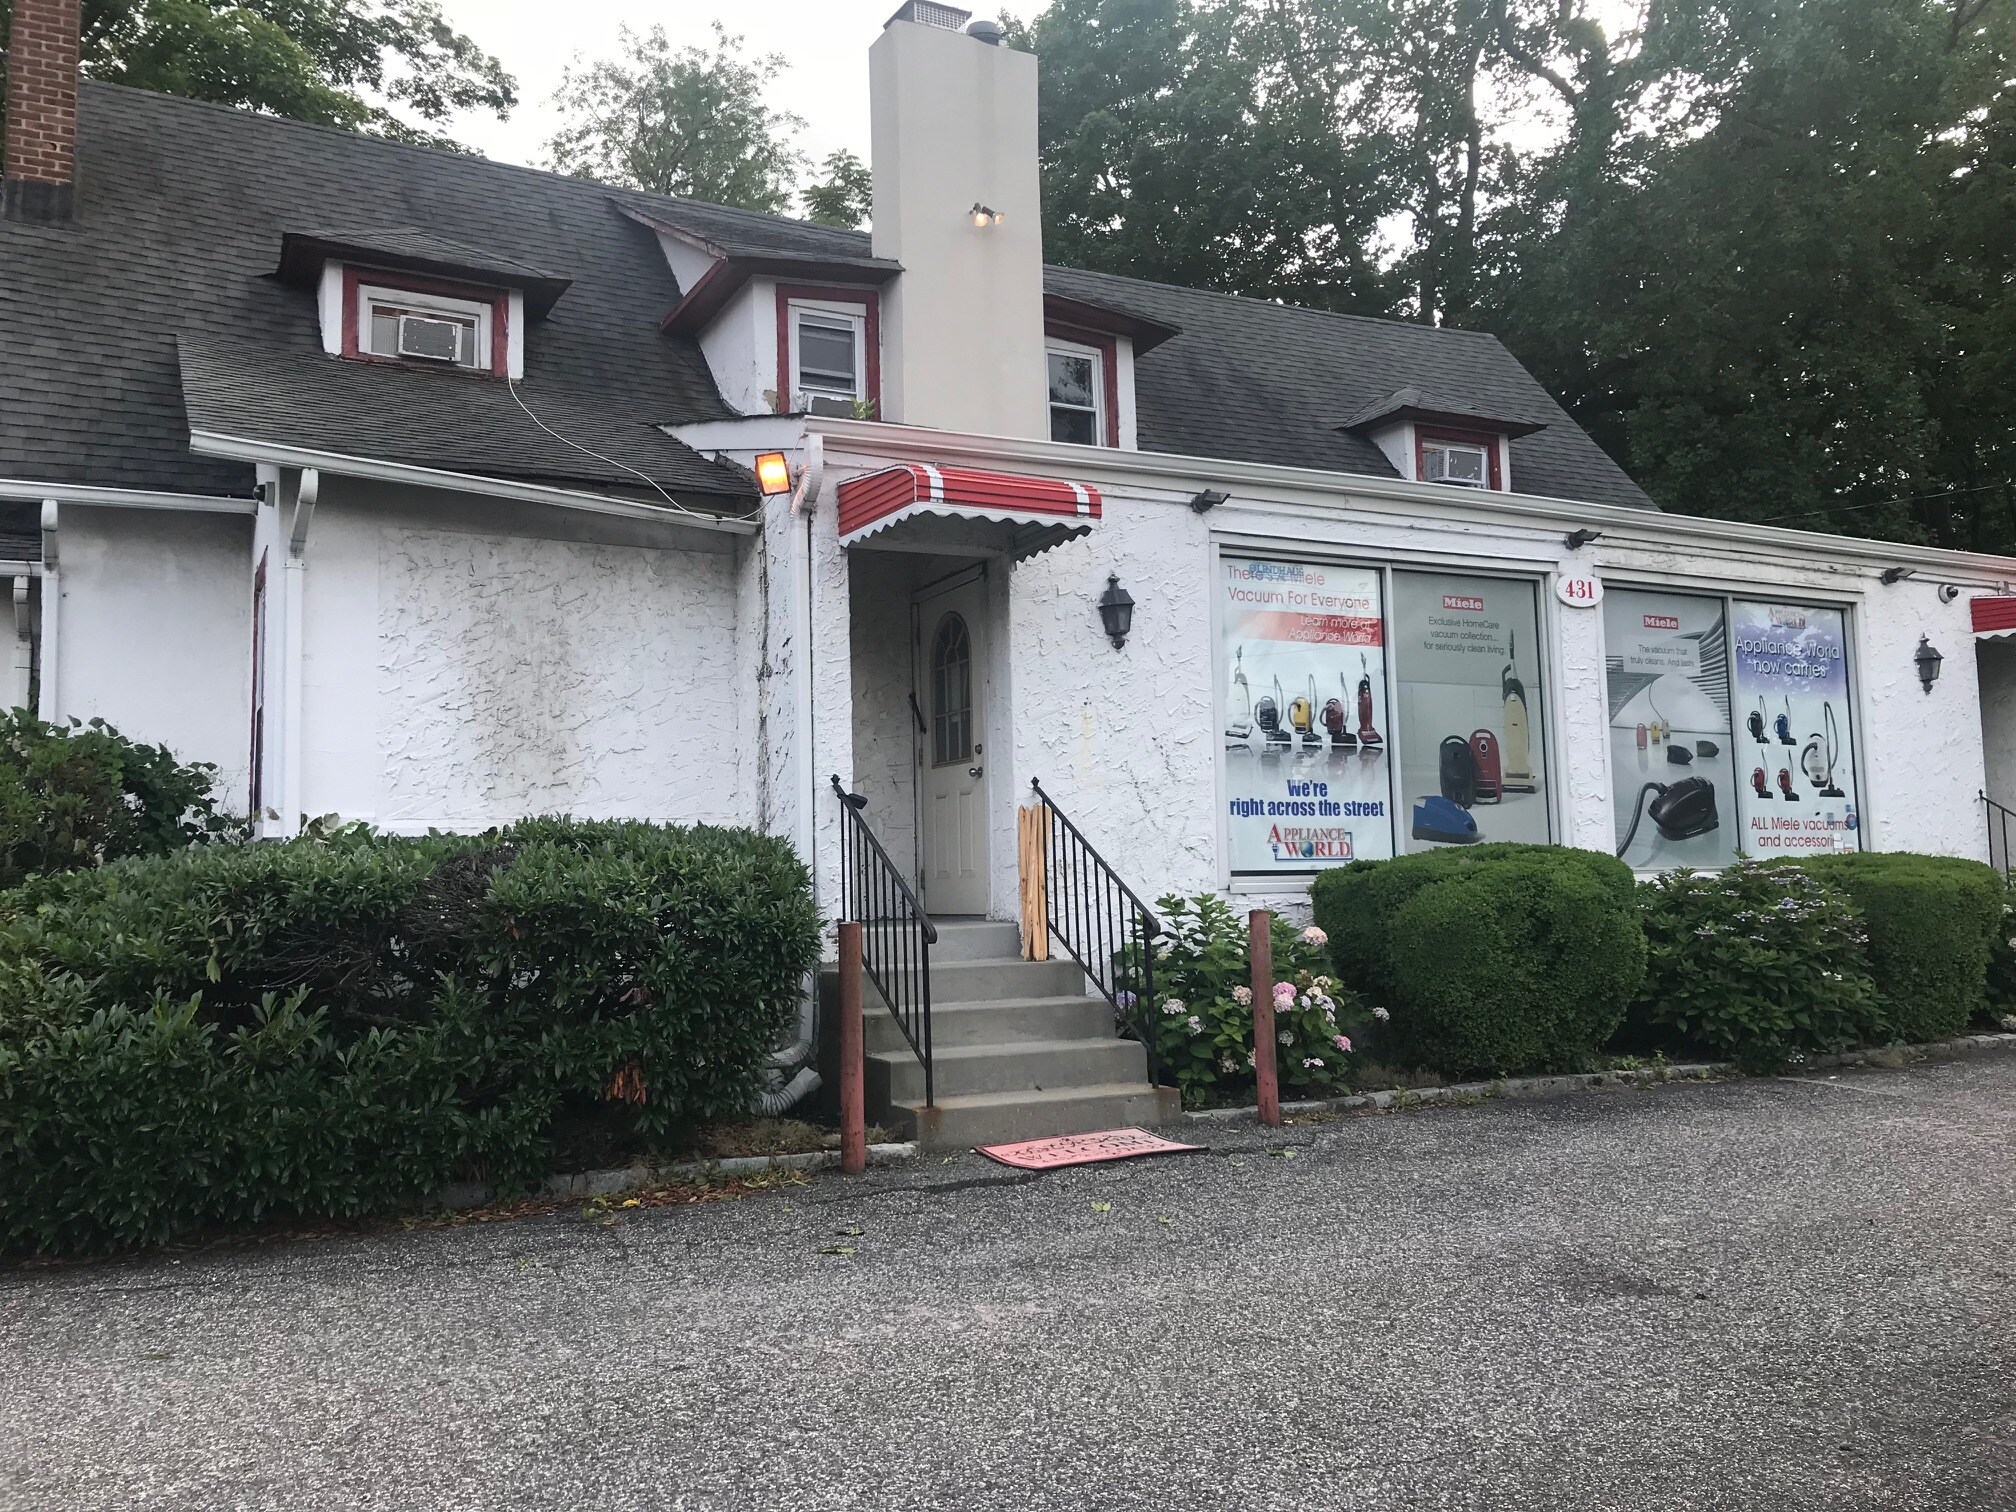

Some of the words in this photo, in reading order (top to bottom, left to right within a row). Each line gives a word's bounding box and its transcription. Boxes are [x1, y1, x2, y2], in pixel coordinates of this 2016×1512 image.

[1227, 565, 1273, 582] Theres
[1566, 579, 1594, 599] 431
[1228, 587, 1284, 603] Vacuum
[1288, 591, 1308, 605] For
[1311, 593, 1370, 610] Everyone
[1443, 597, 1483, 610] Miele
[1301, 615, 1329, 627] Learn
[1331, 618, 1358, 628] more
[1360, 619, 1371, 629] at
[1428, 616, 1461, 627] Exclusive
[1462, 618, 1500, 629] HomeCare
[1644, 616, 1678, 628] Miele
[1288, 628, 1340, 642] Appliance
[1343, 631, 1372, 643] World
[1430, 630, 1458, 639] vacuum
[1424, 640, 1434, 650] for
[1435, 643, 1466, 653] seriously
[1467, 644, 1486, 653] clean
[1638, 644, 1651, 653] The
[1651, 646, 1675, 655] vacuum
[1675, 647, 1688, 655] that
[1735, 636, 1802, 656] Appliance
[1806, 639, 1840, 659] World
[1630, 656, 1643, 666] truly
[1668, 658, 1680, 667] And
[1753, 659, 1781, 674] now
[1784, 661, 1827, 678] carries
[1286, 779, 1328, 797] We're
[1230, 798, 1265, 817] right
[1268, 801, 1316, 816] across
[1319, 799, 1341, 816] the
[1344, 800, 1384, 817] street
[1751, 817, 1768, 830] ALL
[1771, 817, 1800, 830] Miele
[1803, 820, 1849, 831] vacuums
[1267, 823, 1346, 844] APPLIANCE
[1758, 834, 1780, 847] and
[1784, 835, 1834, 847] accessori
[1284, 841, 1351, 858] WORLD
